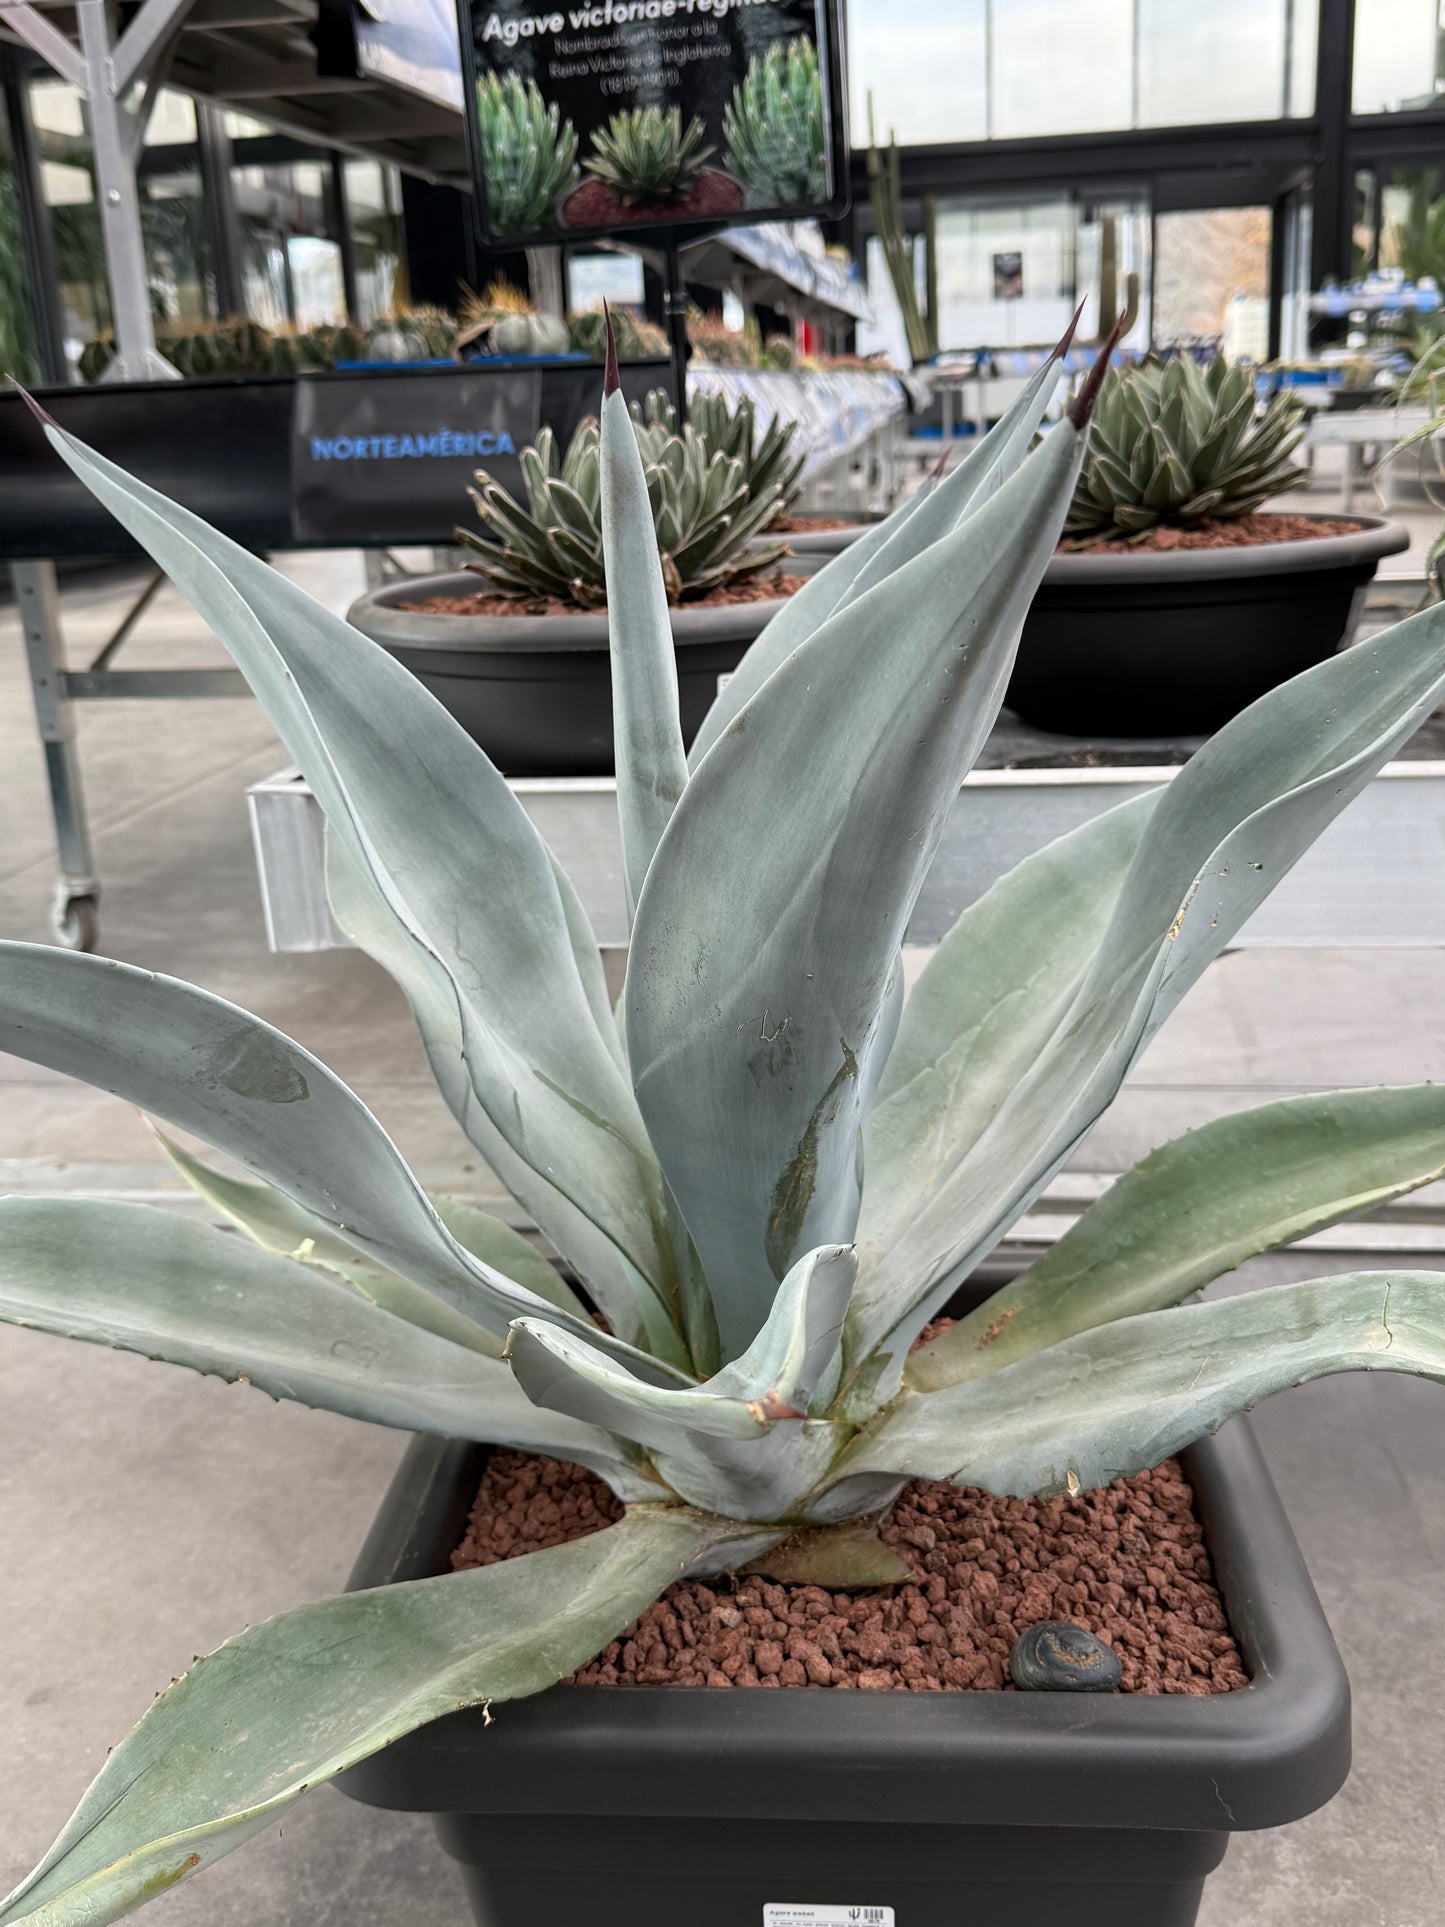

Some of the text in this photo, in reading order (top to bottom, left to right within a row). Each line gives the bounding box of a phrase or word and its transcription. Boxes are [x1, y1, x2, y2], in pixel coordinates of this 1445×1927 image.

[482, 12, 565, 47] Agave
[549, 60, 590, 79] Reina
[588, 53, 642, 75] Victoria
[663, 43, 732, 67] Inglaterra
[311, 428, 516, 461] NORTEAMÉRICA
